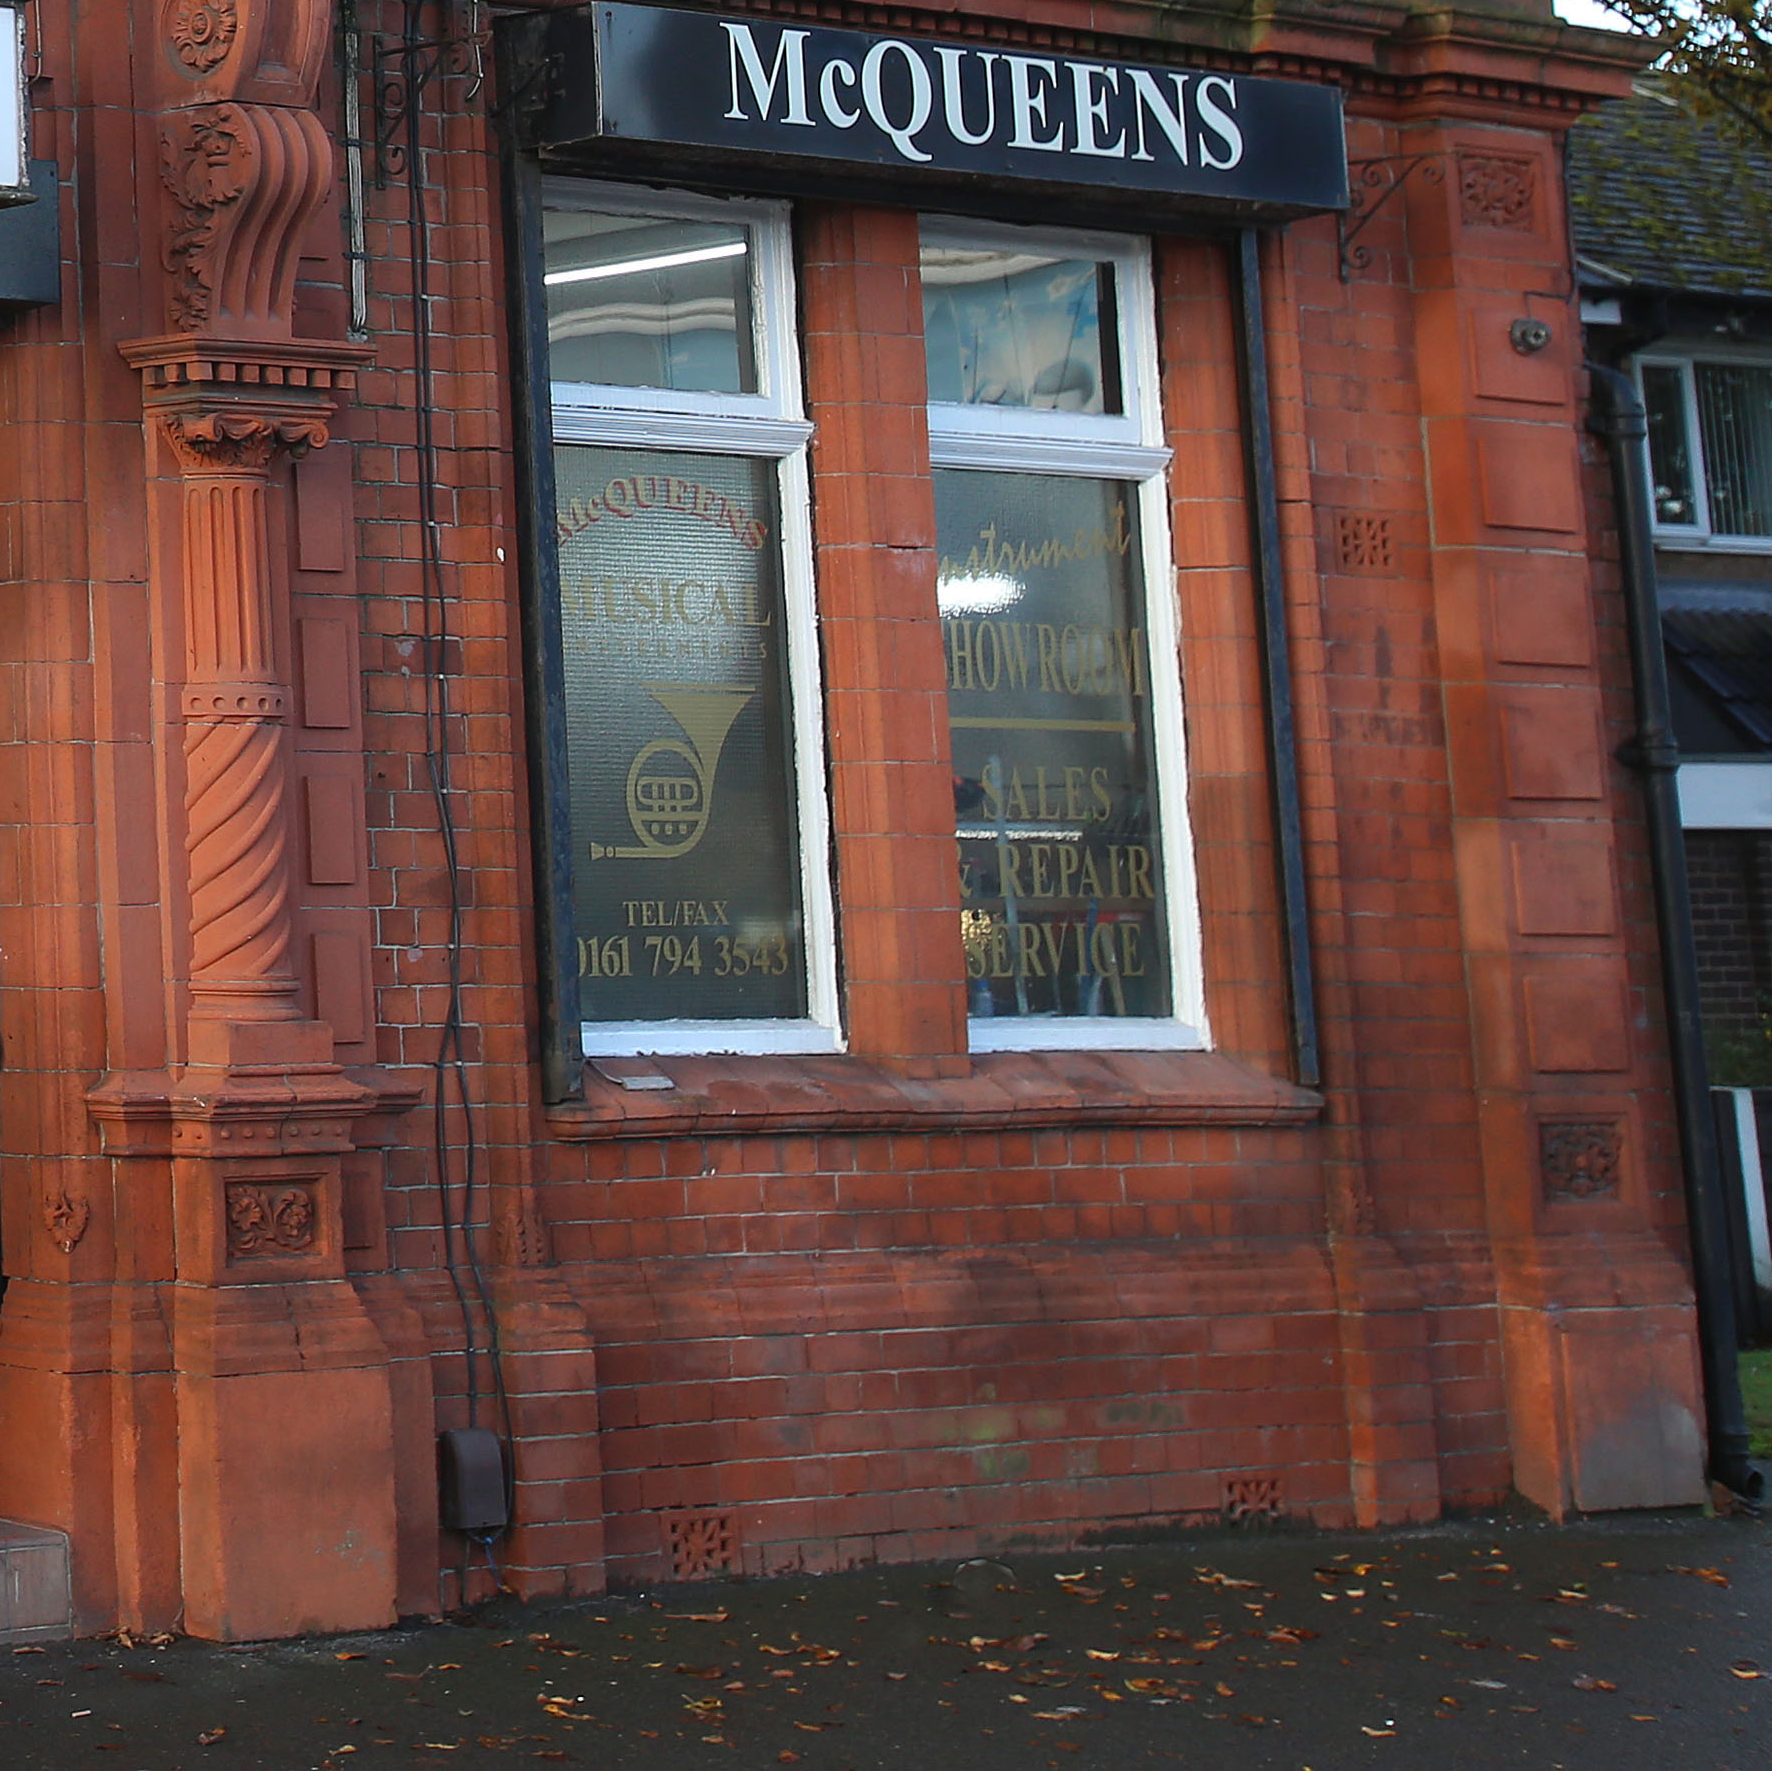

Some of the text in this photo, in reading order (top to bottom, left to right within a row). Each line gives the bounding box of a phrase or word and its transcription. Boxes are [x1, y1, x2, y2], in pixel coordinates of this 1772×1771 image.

[719, 22, 1244, 171] McQUEENS
[938, 500, 1132, 580] nstrument
[560, 577, 772, 627] MUSICAL
[948, 619, 1146, 696] HOWROOM
[981, 764, 1113, 822] SALES
[995, 843, 1155, 900] REPAIR
[622, 900, 730, 927] TEL/FAX
[643, 935, 703, 977] 794
[713, 933, 789, 976] 3543
